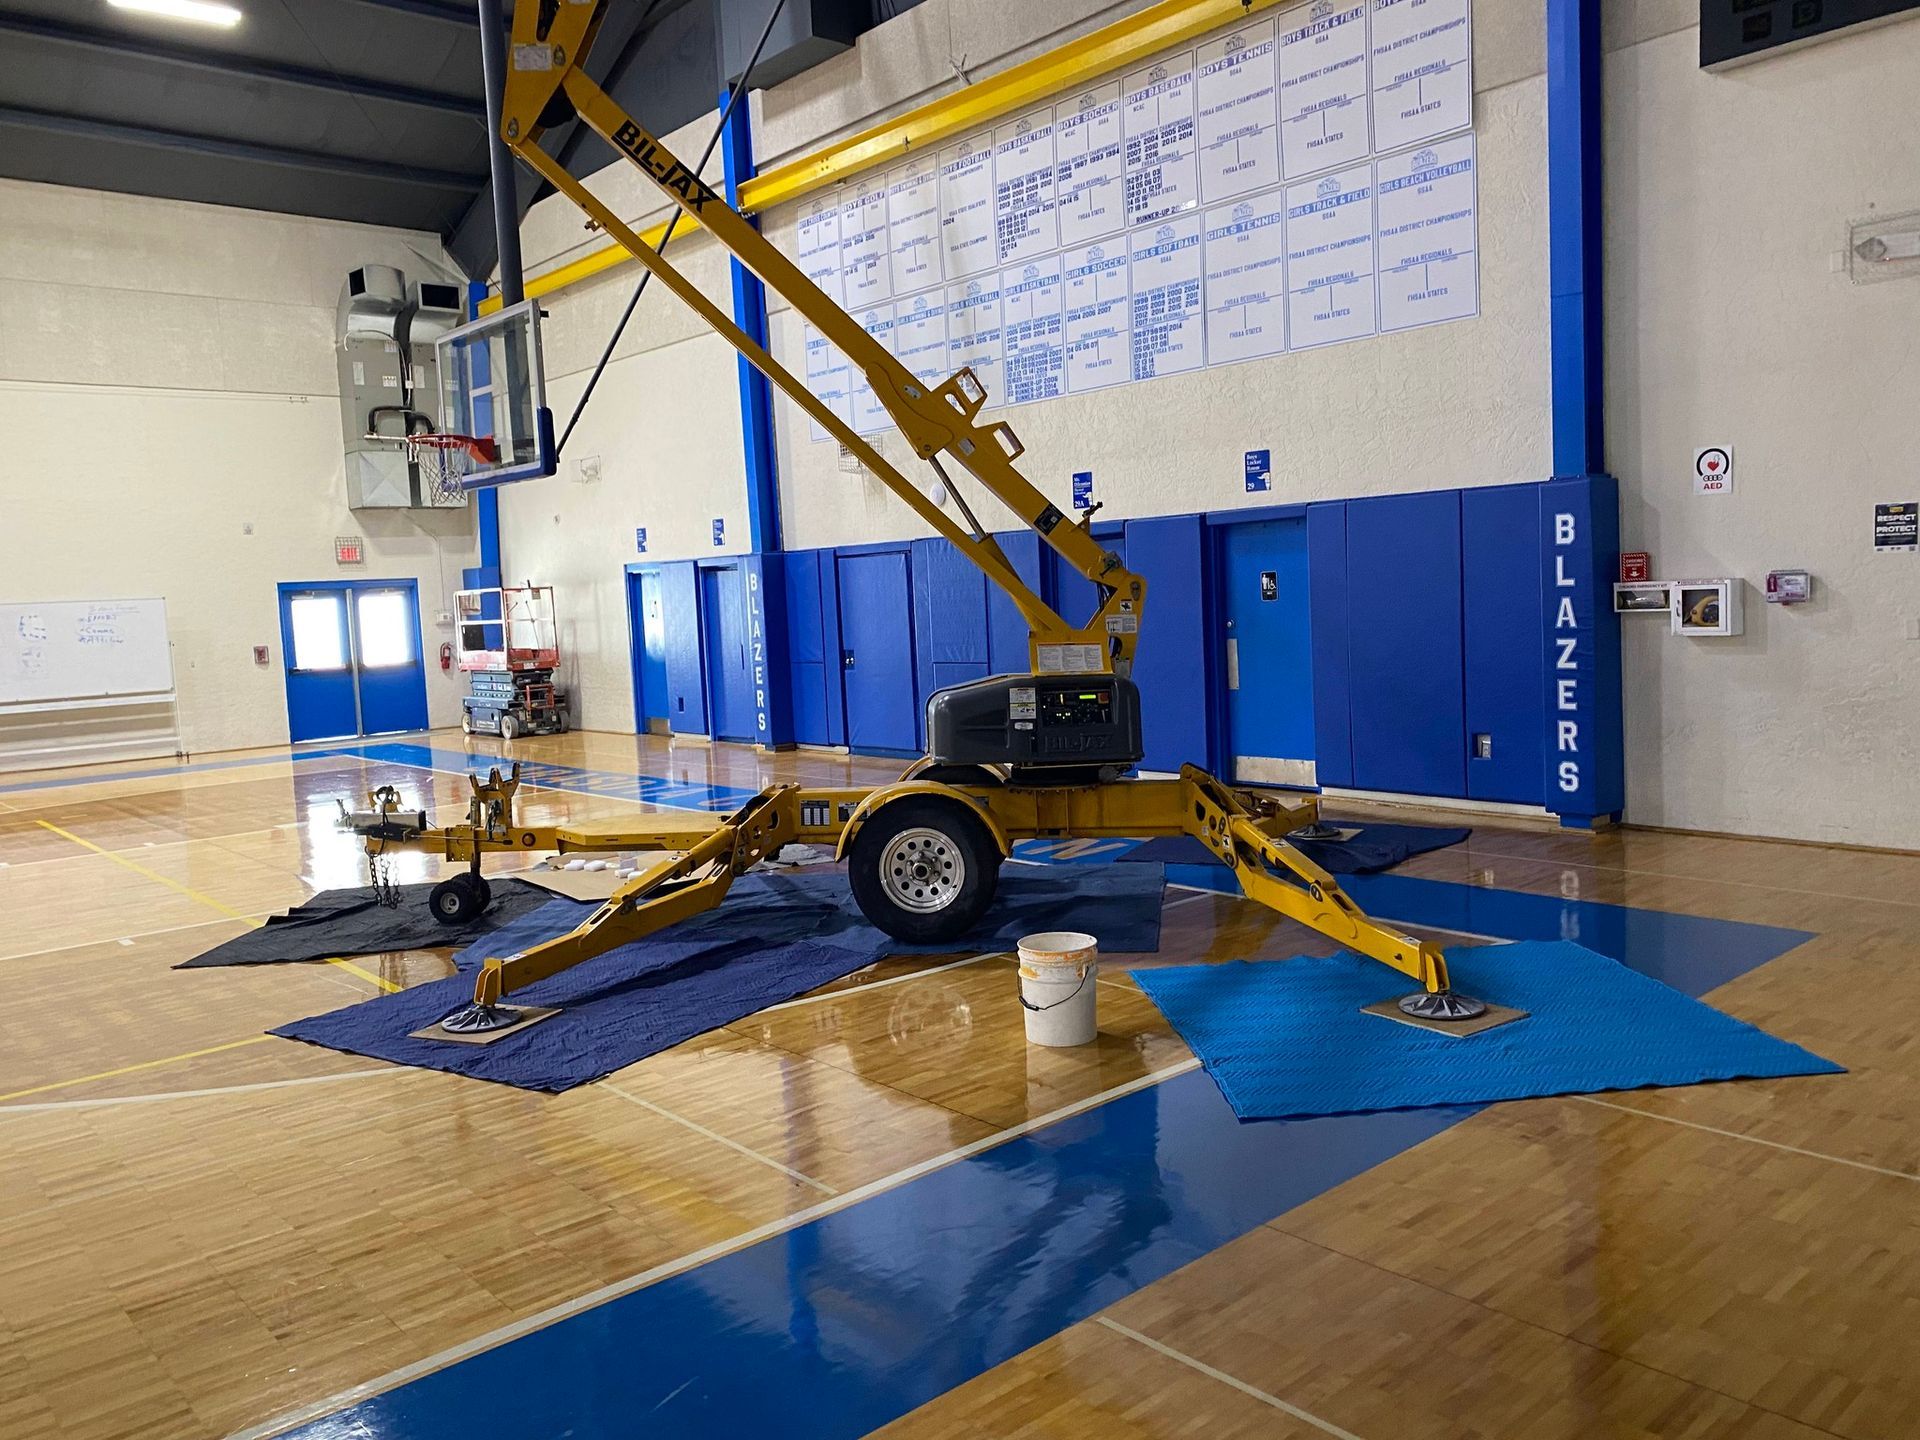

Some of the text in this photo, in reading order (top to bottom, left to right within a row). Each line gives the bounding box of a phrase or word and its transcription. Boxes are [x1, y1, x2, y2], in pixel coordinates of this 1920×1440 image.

[1281, 29, 1302, 47] BOYS
[1304, 19, 1329, 38] TRACK
[1341, 6, 1363, 24] FIELD
[1373, 17, 1465, 56] FHSAA DISTRICT CHAMPIONSHIPS
[1199, 41, 1272, 78] BOYS TENNIS
[1282, 54, 1363, 88] FHSAA DISTRICT CHAMPIONSHIPS
[1394, 59, 1445, 82] FHSAA REGIONALS
[1125, 72, 1191, 106] BOYS BASEBALL
[1200, 86, 1272, 118] FHSAA DISTRICT CHAMPIONSHIPS
[1301, 93, 1346, 114] FHSAA REGIONALS
[1401, 100, 1440, 119] FHSAA STATES
[1057, 101, 1118, 132] BOYS SOCCER
[1127, 121, 1192, 150] 1992 2004 2005 2006
[1140, 127, 1158, 138] DISTRICT
[1159, 115, 1192, 132] CHAMPIONSHIPS
[1232, 123, 1258, 137] REGIONALS
[1013, 126, 1051, 148] BASKETBALL
[1127, 130, 1192, 158] 2007 2010 2012 2014
[1307, 131, 1343, 149] FHSAA STATES
[960, 150, 990, 168] FOOTBALL
[1090, 148, 1119, 164] 1993 1994
[1128, 150, 1158, 165] 2015 2016
[1238, 159, 1255, 170] STATES
[614, 120, 713, 213] BIL-JAX
[1379, 159, 1470, 193] GIRLS BEACH VOLLEYBALL
[1012, 188, 1023, 197] 2001
[1028, 202, 1054, 216] 2014 2015
[1288, 203, 1310, 218] GIRLS
[1312, 196, 1336, 212] TRACK
[1348, 187, 1369, 202] FIELD
[1136, 207, 1169, 224] RUNNER-UP
[1380, 208, 1471, 237] FHSAA DISTRICT CHAMPIONSHIPS
[1207, 212, 1279, 241] GIRLS TENNIS
[1133, 235, 1198, 261] GIRLS SOFTBALL
[1289, 233, 1370, 260] FHSAA DISTRICT CHAMPIONSHIPS
[1401, 248, 1451, 265] FHSAA REGIONALS
[1066, 256, 1125, 280] GIRLS SOCCER
[1208, 257, 1280, 280] FHSAA DISTRICT CHAMPIONSHIPS
[1022, 274, 1058, 292] BASKETBALL
[1148, 285, 1165, 295] DISTRICT
[1166, 277, 1198, 290] CHAMPIONSHIPS
[1308, 271, 1353, 286] FHSAA REGIONALS
[1167, 288, 1182, 297] 2000
[1184, 284, 1198, 293] 2004
[1407, 287, 1447, 301] FHSAA STATES
[1134, 303, 1148, 312] 2005
[1167, 295, 1181, 305] 2010
[1134, 310, 1147, 319] 2012
[1151, 307, 1164, 315] 2014
[1168, 303, 1181, 312] 2015
[1067, 313, 1080, 321] 2004
[1097, 306, 1110, 314] 2007
[1135, 318, 1147, 326] 2017
[1314, 308, 1349, 321] FHSAA STATES
[875, 320, 892, 331] GOLF
[1168, 322, 1182, 331] 2014
[1247, 482, 1255, 490] 29
[1876, 514, 1916, 522] RESPECT
[750, 573, 766, 730] BLAZERS
[1554, 512, 1580, 793] BLAZERS
